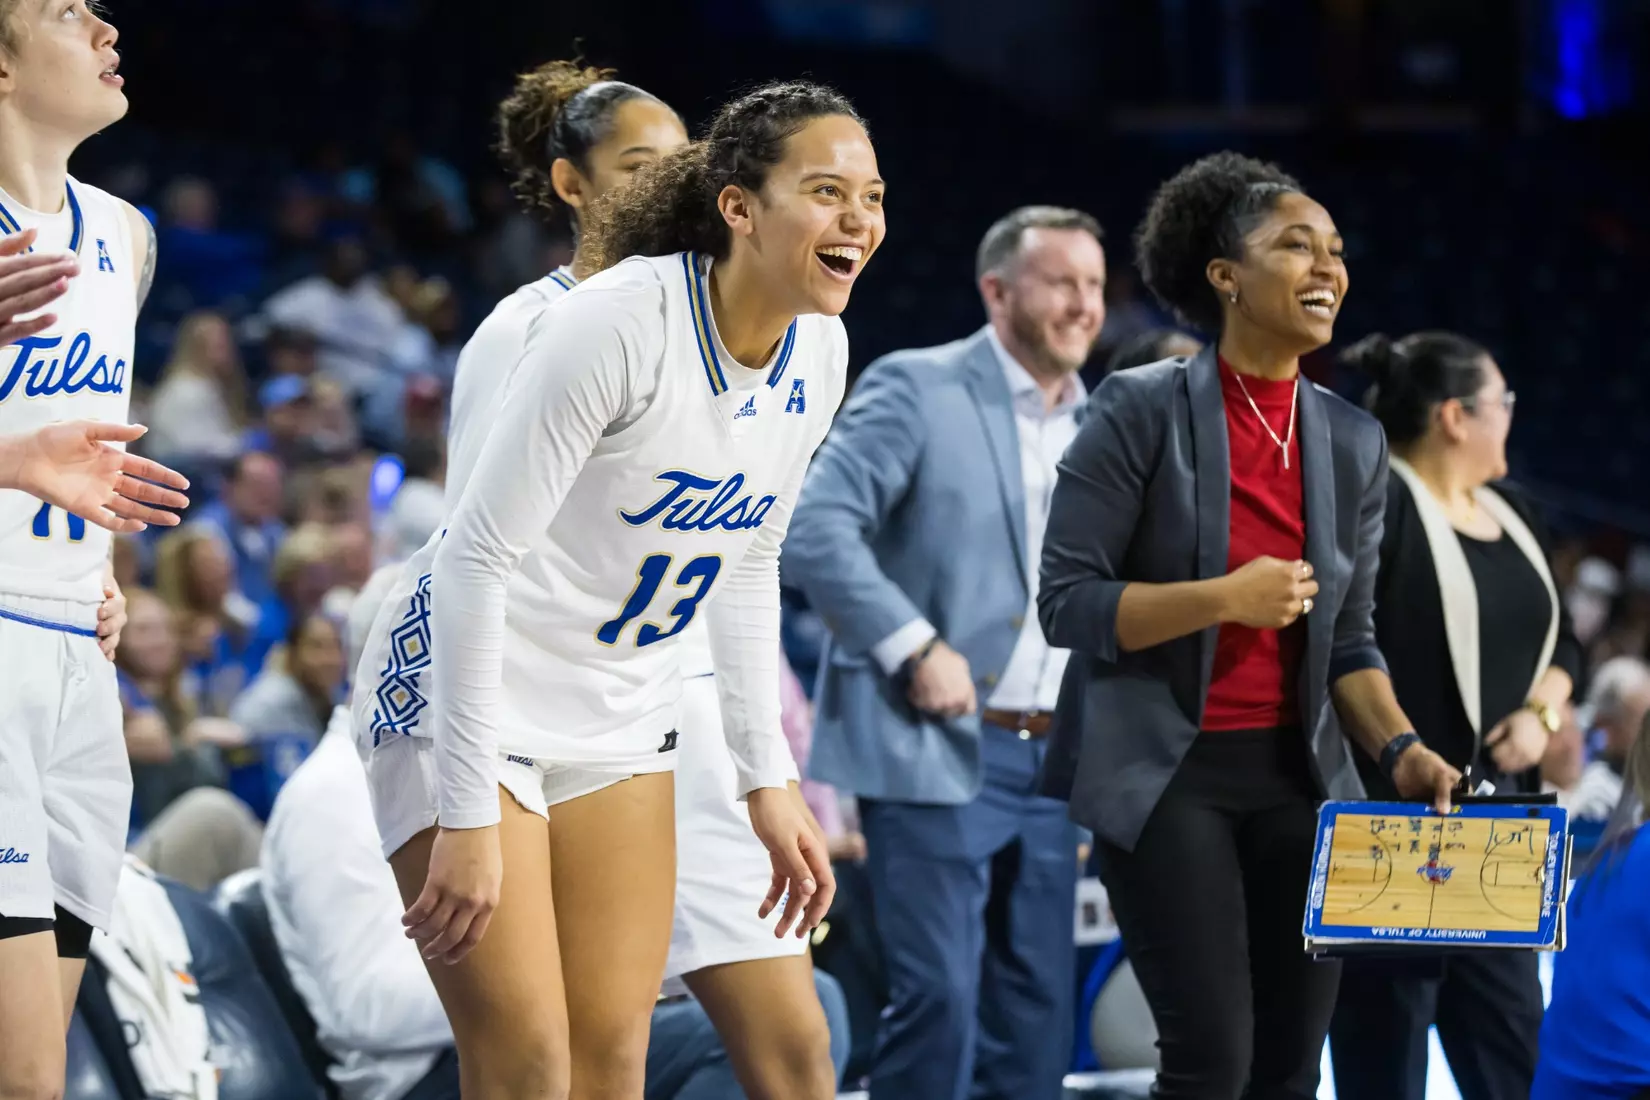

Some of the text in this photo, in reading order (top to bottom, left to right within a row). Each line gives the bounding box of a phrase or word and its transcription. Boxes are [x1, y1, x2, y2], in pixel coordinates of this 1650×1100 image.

[618, 468, 778, 534] Tulsa
[595, 553, 722, 648] 13
[1371, 926, 1487, 939] UNIVERSITY OF TULSA
